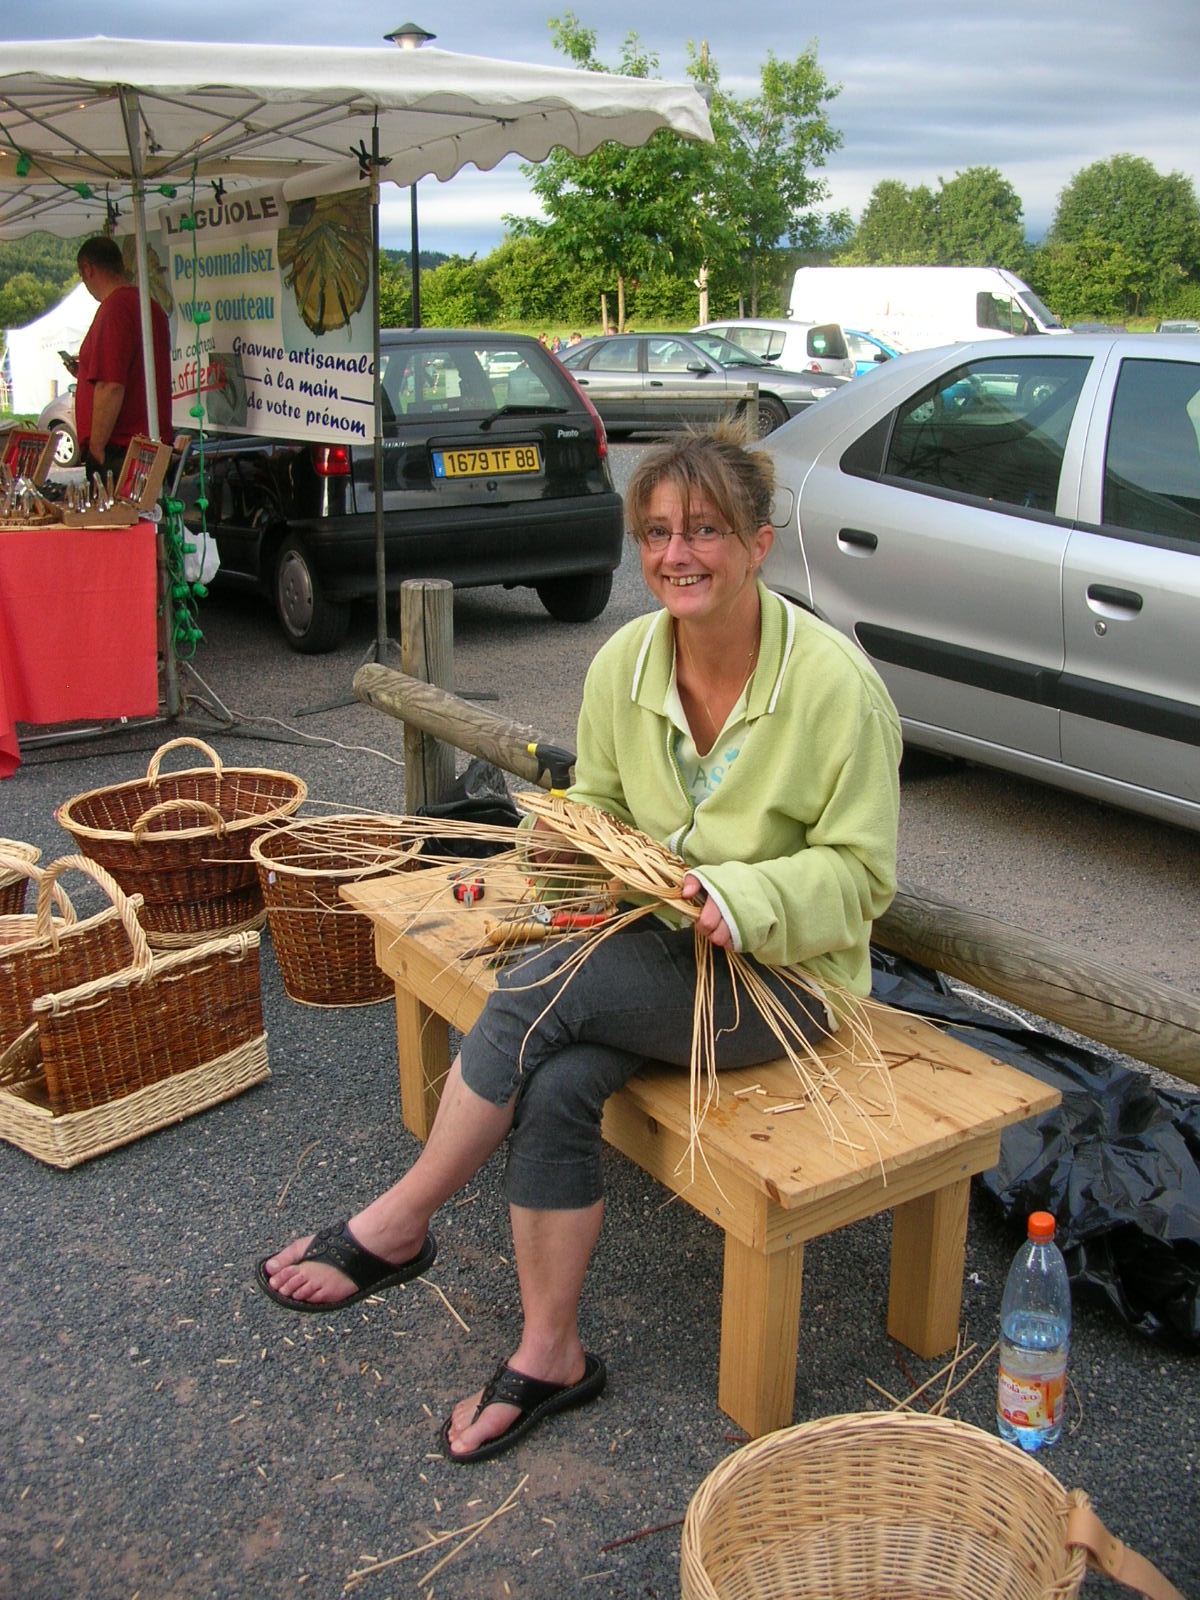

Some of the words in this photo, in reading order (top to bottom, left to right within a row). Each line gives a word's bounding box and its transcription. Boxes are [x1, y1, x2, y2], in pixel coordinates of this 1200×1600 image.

[174, 244, 275, 280] Personnalisez
[178, 300, 211, 322] vore
[215, 292, 274, 321] couteau
[232, 336, 284, 360] Gravure
[264, 367, 273, 386] à
[277, 371, 294, 391] la
[299, 379, 338, 399] main
[247, 391, 263, 410] de
[266, 400, 301, 419] votre
[306, 407, 366, 437] prénom
[557, 430, 579, 438] Punto
[448, 452, 489, 472] 1679
[491, 450, 511, 469] TF
[515, 449, 535, 468] 88
